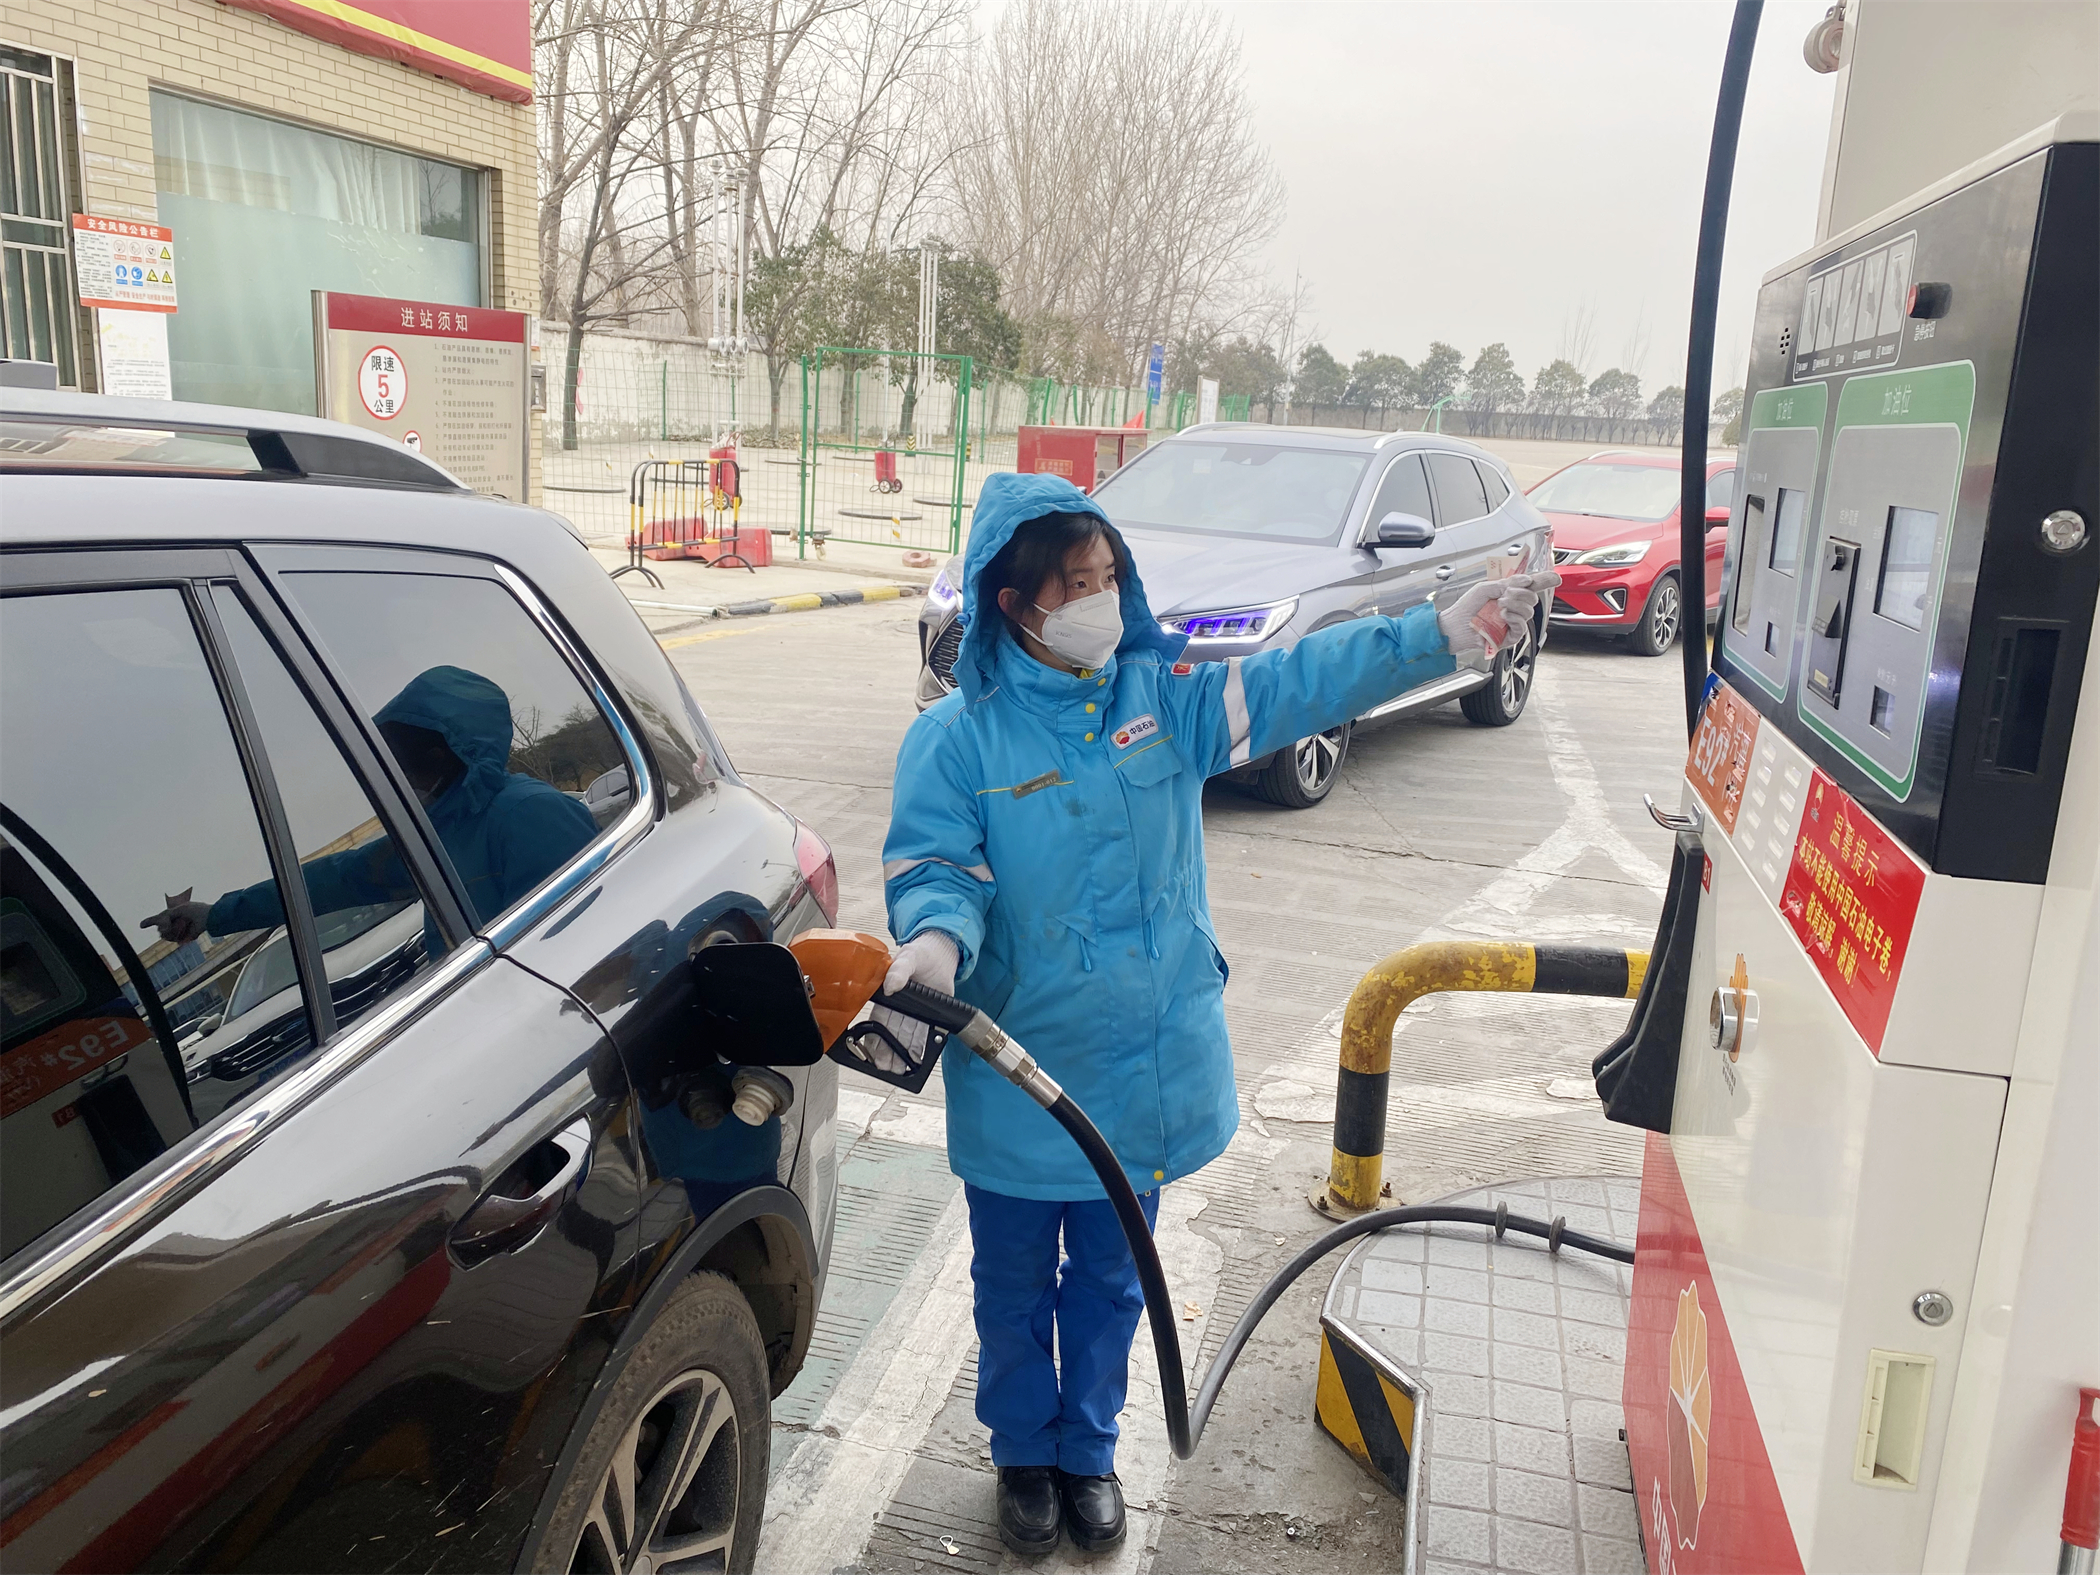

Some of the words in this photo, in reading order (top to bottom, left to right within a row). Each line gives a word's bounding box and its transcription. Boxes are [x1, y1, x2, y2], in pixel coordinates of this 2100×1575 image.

[87, 218, 159, 238] 安全风险公告栏
[400, 306, 469, 333] 进站须知
[371, 355, 395, 372] 限速
[377, 374, 390, 398] 5
[374, 399, 395, 414] 公里
[1129, 720, 1155, 735] 中国石油
[1829, 811, 1880, 887] 温馨提示
[1652, 1475, 1677, 1575] 中国
